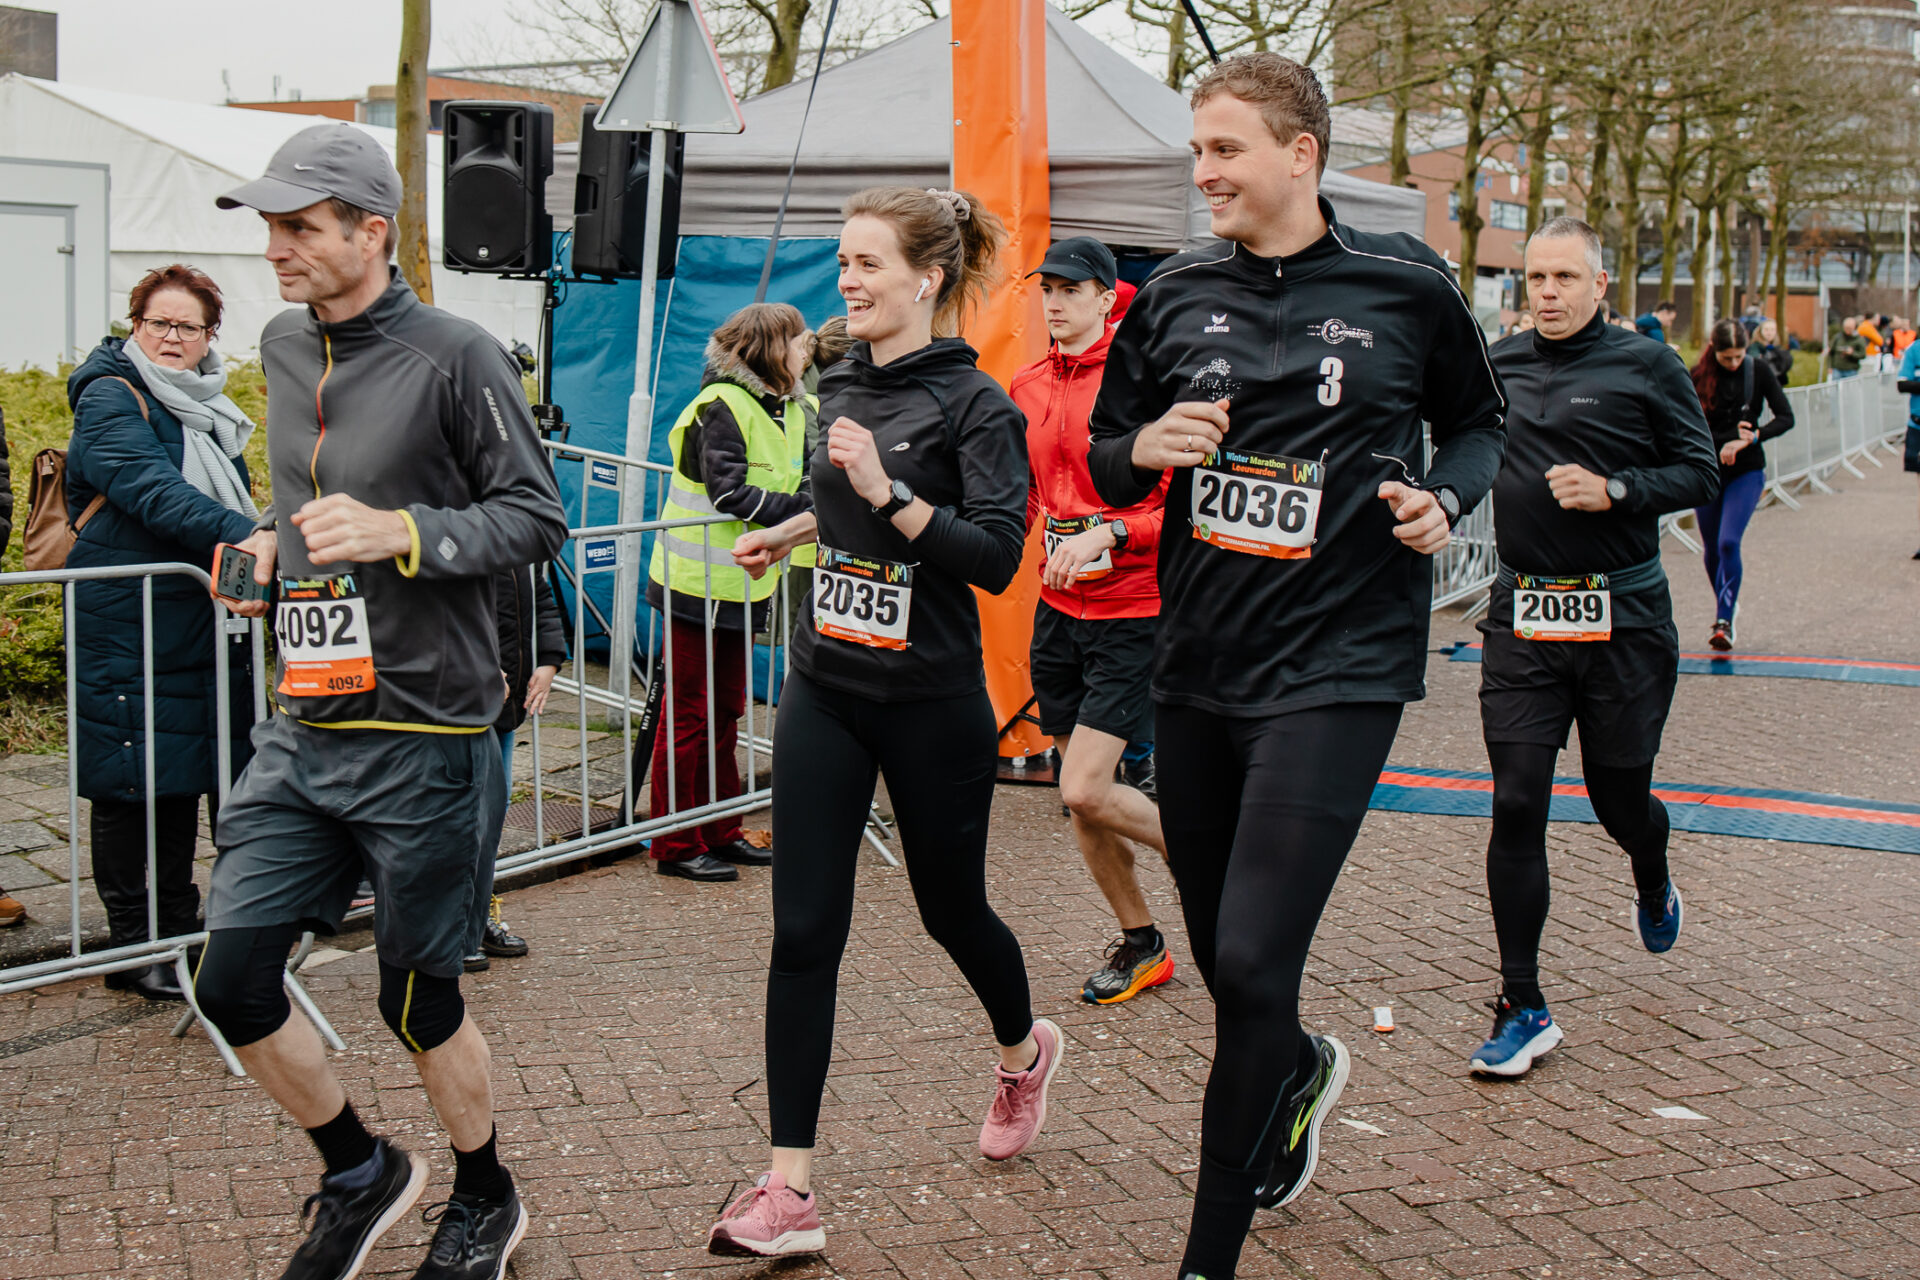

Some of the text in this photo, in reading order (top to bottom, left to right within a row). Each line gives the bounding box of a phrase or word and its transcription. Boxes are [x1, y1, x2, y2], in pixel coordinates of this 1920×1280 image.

[1204, 325, 1230, 333] erima
[1317, 356, 1344, 407] 3
[1226, 451, 1287, 469] Winter Marathon
[1231, 463, 1277, 478] Leeuwarden
[1198, 474, 1309, 534] 2036
[817, 573, 900, 626] 2035
[1521, 593, 1604, 623] 2089
[279, 604, 358, 649] 4092
[327, 675, 365, 691] 4092
